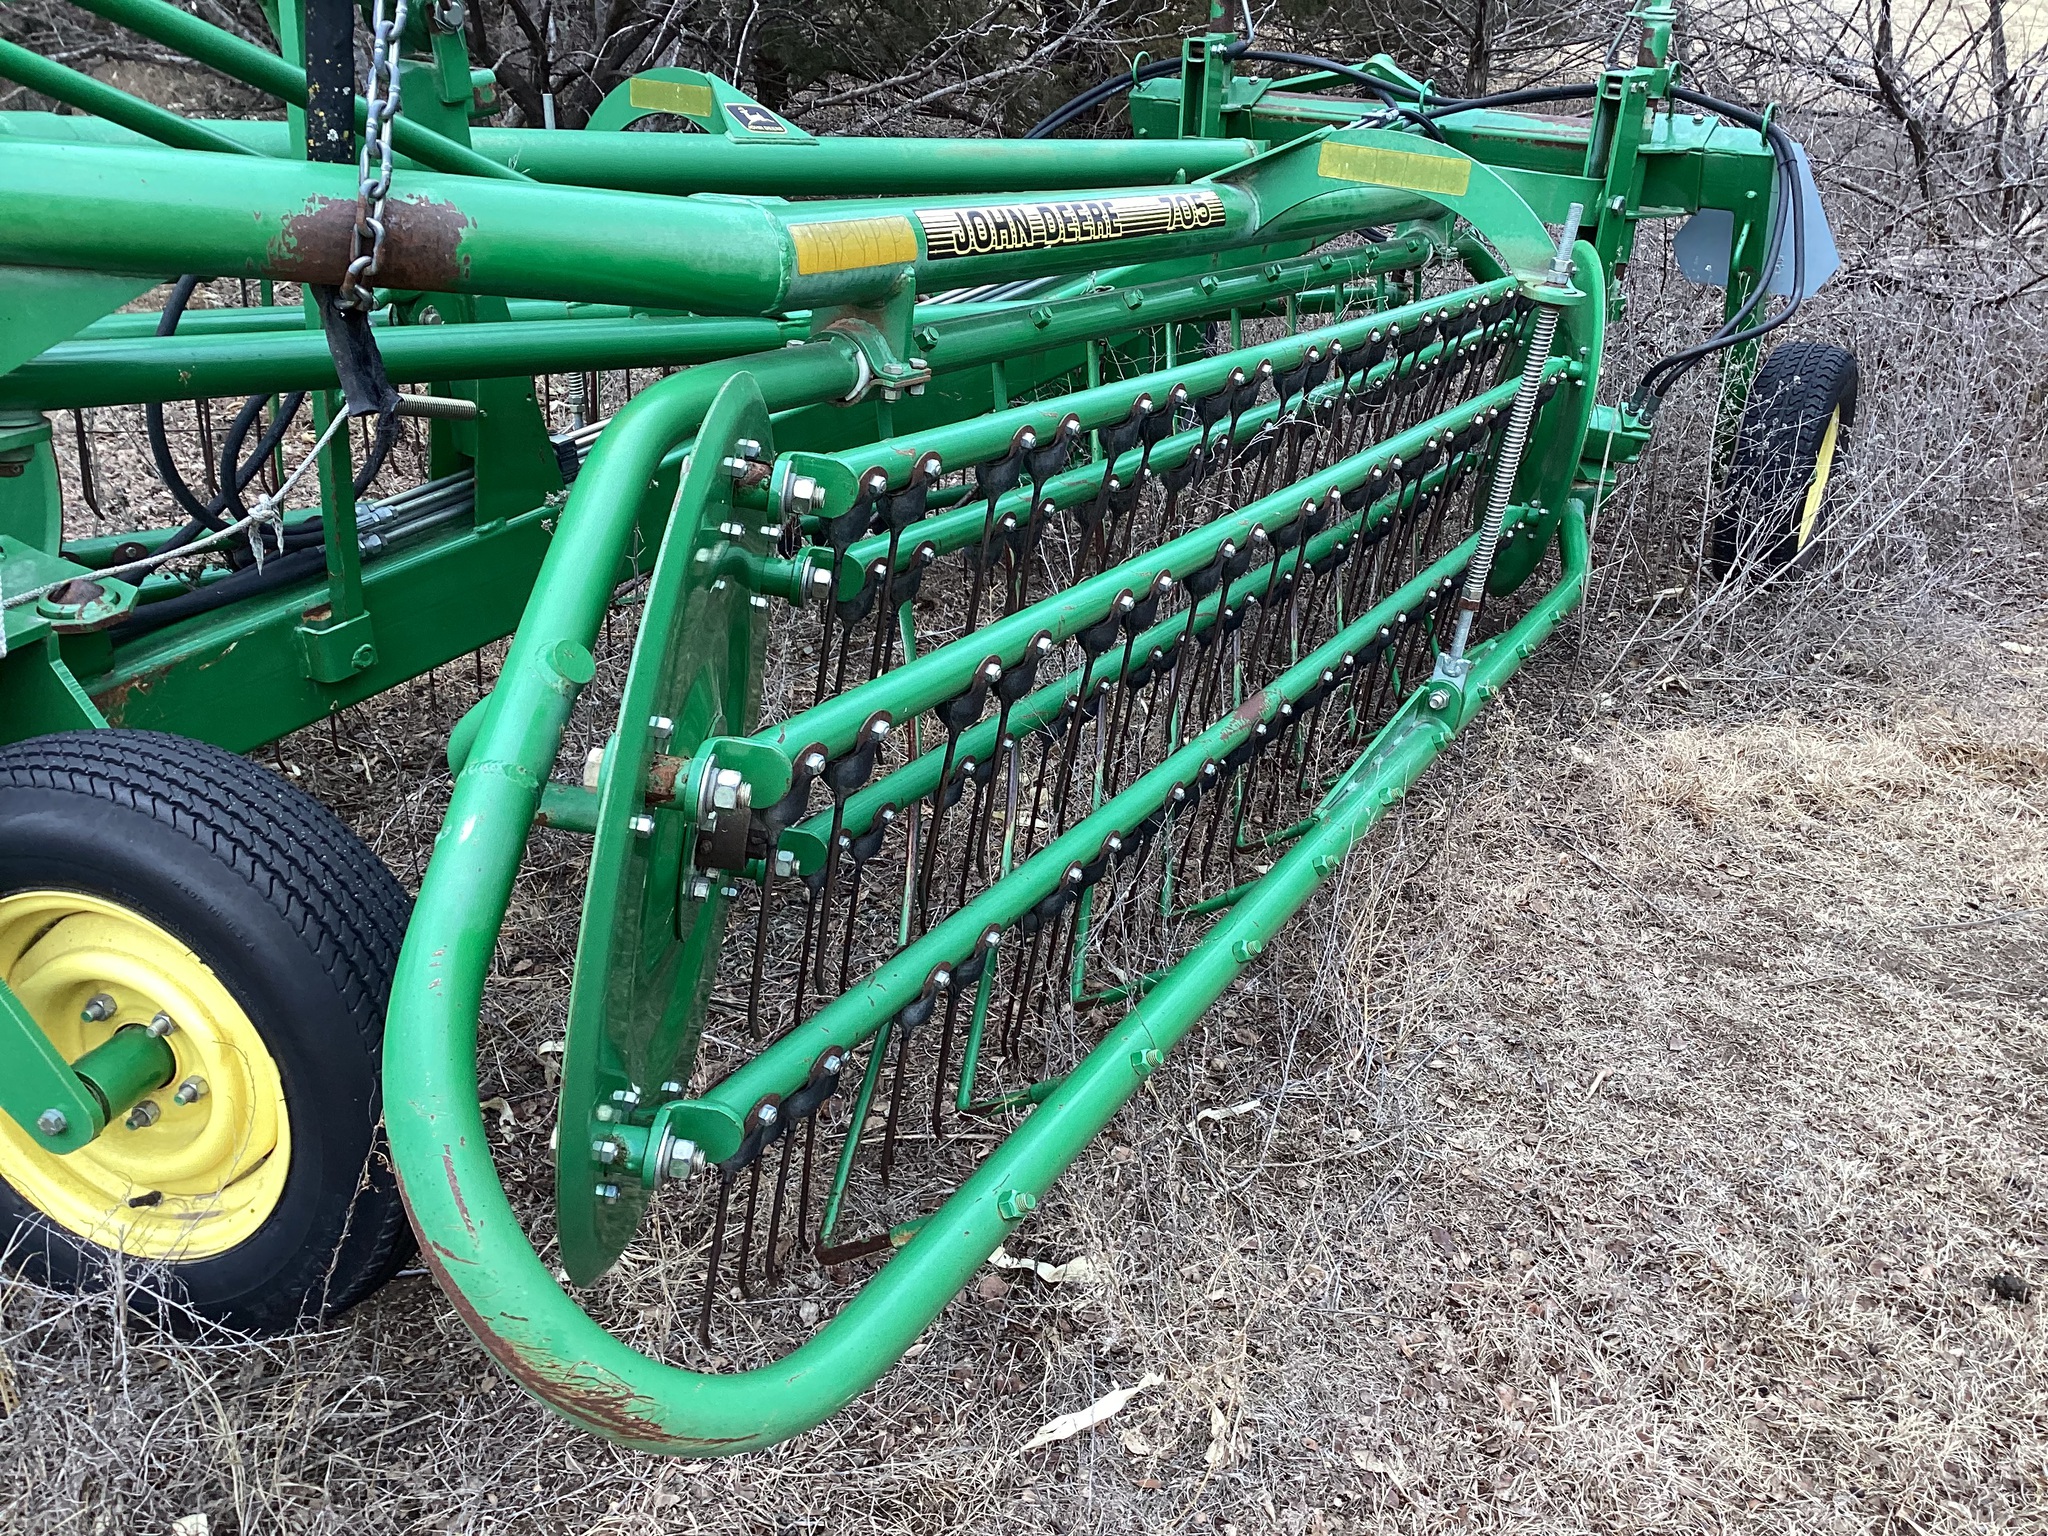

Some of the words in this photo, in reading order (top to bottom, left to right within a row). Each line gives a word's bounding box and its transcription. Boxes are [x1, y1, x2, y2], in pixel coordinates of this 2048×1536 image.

[952, 208, 1035, 254] JOHN
[1039, 201, 1122, 245] DEERE
[1158, 194, 1212, 230] 705
